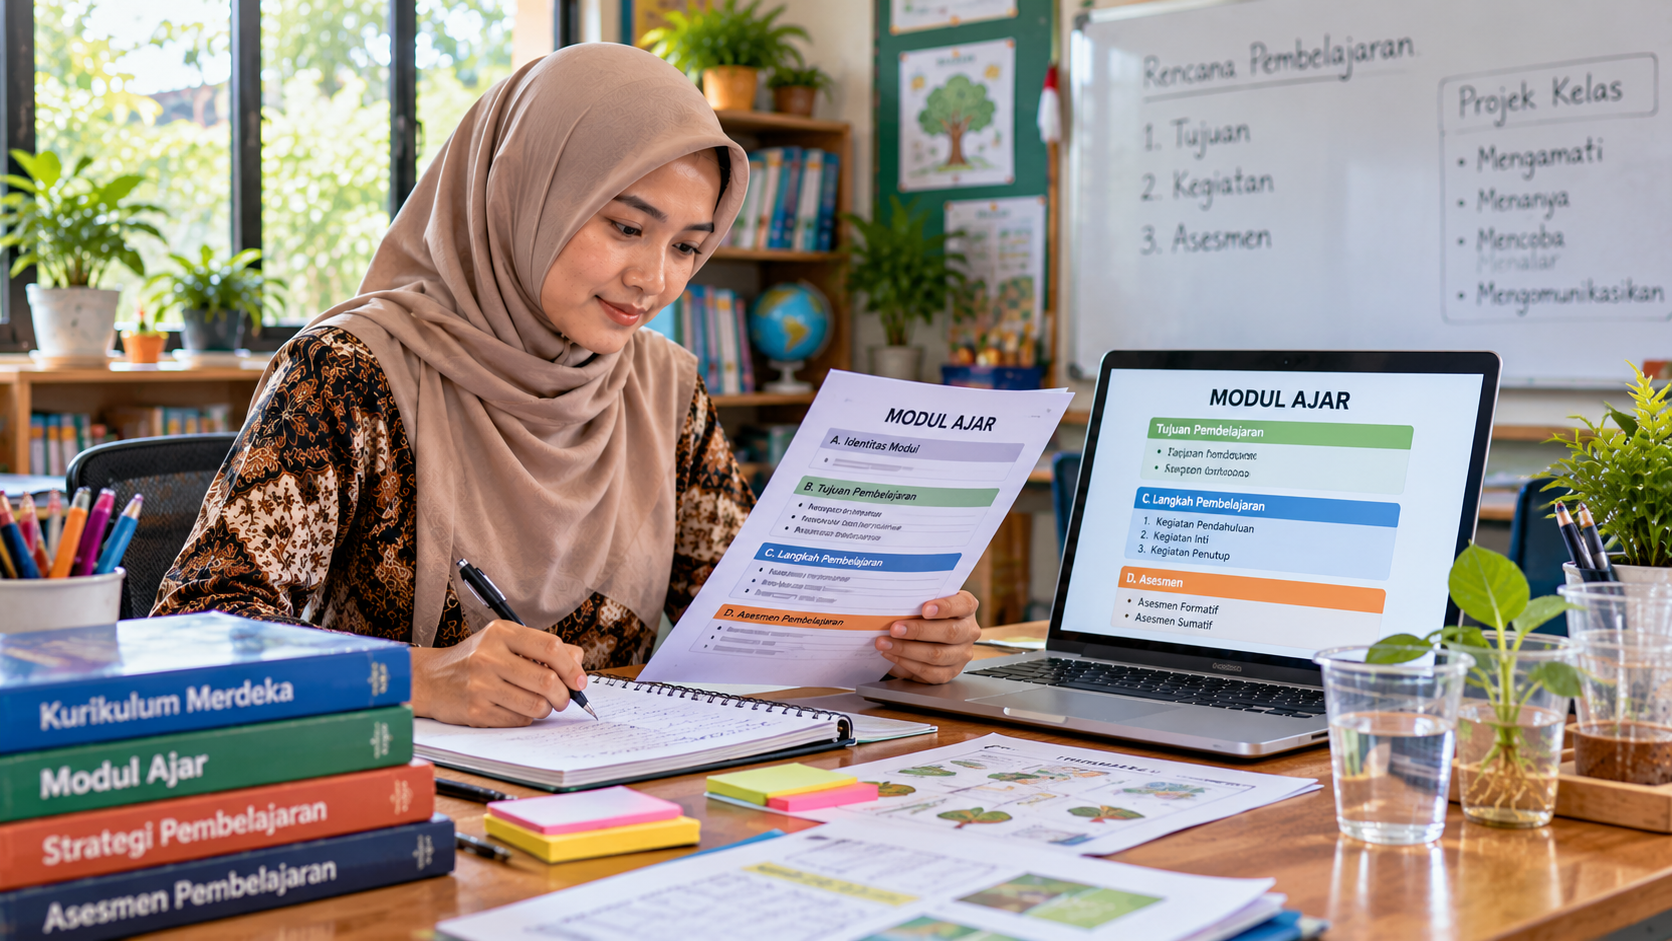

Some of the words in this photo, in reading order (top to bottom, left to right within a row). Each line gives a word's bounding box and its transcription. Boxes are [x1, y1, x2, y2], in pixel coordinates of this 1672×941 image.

[1143, 54, 1237, 89] Rencana
[1249, 32, 1415, 82] Pembelajaran
[1458, 79, 1537, 128] Projek
[1551, 71, 1623, 107] Kelas
[1143, 122, 1162, 152] 1.
[1169, 117, 1251, 161] Tujuan
[1476, 136, 1604, 182] Mengamati
[1141, 172, 1163, 202] 2.
[1172, 166, 1275, 211] Kegiatan
[1476, 186, 1570, 221] Menanya
[1139, 224, 1163, 255] 3.
[1170, 221, 1272, 254] Asesmen
[1476, 222, 1565, 252] Mencoba
[1475, 277, 1666, 317] Mengomunikasikan
[1209, 388, 1286, 408] MODUL
[1291, 390, 1351, 410] AJAR
[884, 407, 947, 429] MODUL
[951, 415, 997, 432] AJAR
[1156, 423, 1191, 437] Tujuan
[830, 435, 841, 446] A.
[844, 436, 888, 451] Identitas
[803, 481, 814, 492] B.
[817, 484, 851, 496] Tujuan
[852, 487, 917, 502] Pembelajaran
[1142, 493, 1151, 504] C.
[1152, 494, 1194, 508] Langkah
[1196, 497, 1266, 513] Pembelajaran
[1143, 516, 1151, 526] 1.
[1155, 517, 1195, 529] Kegiatan
[1196, 520, 1255, 533] Pendahuluan
[1140, 530, 1149, 540] 2.
[1153, 531, 1192, 544] Kegiatan
[1194, 534, 1210, 545] Inti
[764, 548, 775, 558] C.
[777, 550, 820, 563] Langkah
[1137, 544, 1146, 554] 3.
[1150, 545, 1190, 557] Kegiatan
[1192, 549, 1231, 562] Penutup
[1126, 572, 1137, 584] D.
[1139, 574, 1184, 588] Asesmen
[723, 608, 734, 618] D.
[1137, 597, 1178, 610] Asesmen
[1180, 601, 1220, 615] Formatif
[1134, 612, 1175, 625] Asesmen
[1177, 617, 1214, 630] Sumatif
[39, 690, 182, 732] Kurikulum
[185, 676, 295, 714] Merdeka
[39, 755, 140, 800] Modul
[146, 751, 209, 789] Ajar
[42, 821, 154, 867] Strategi
[160, 801, 328, 847] Pembelajaran
[42, 888, 169, 935] Asesmen
[174, 860, 337, 911] Pembelajaran
